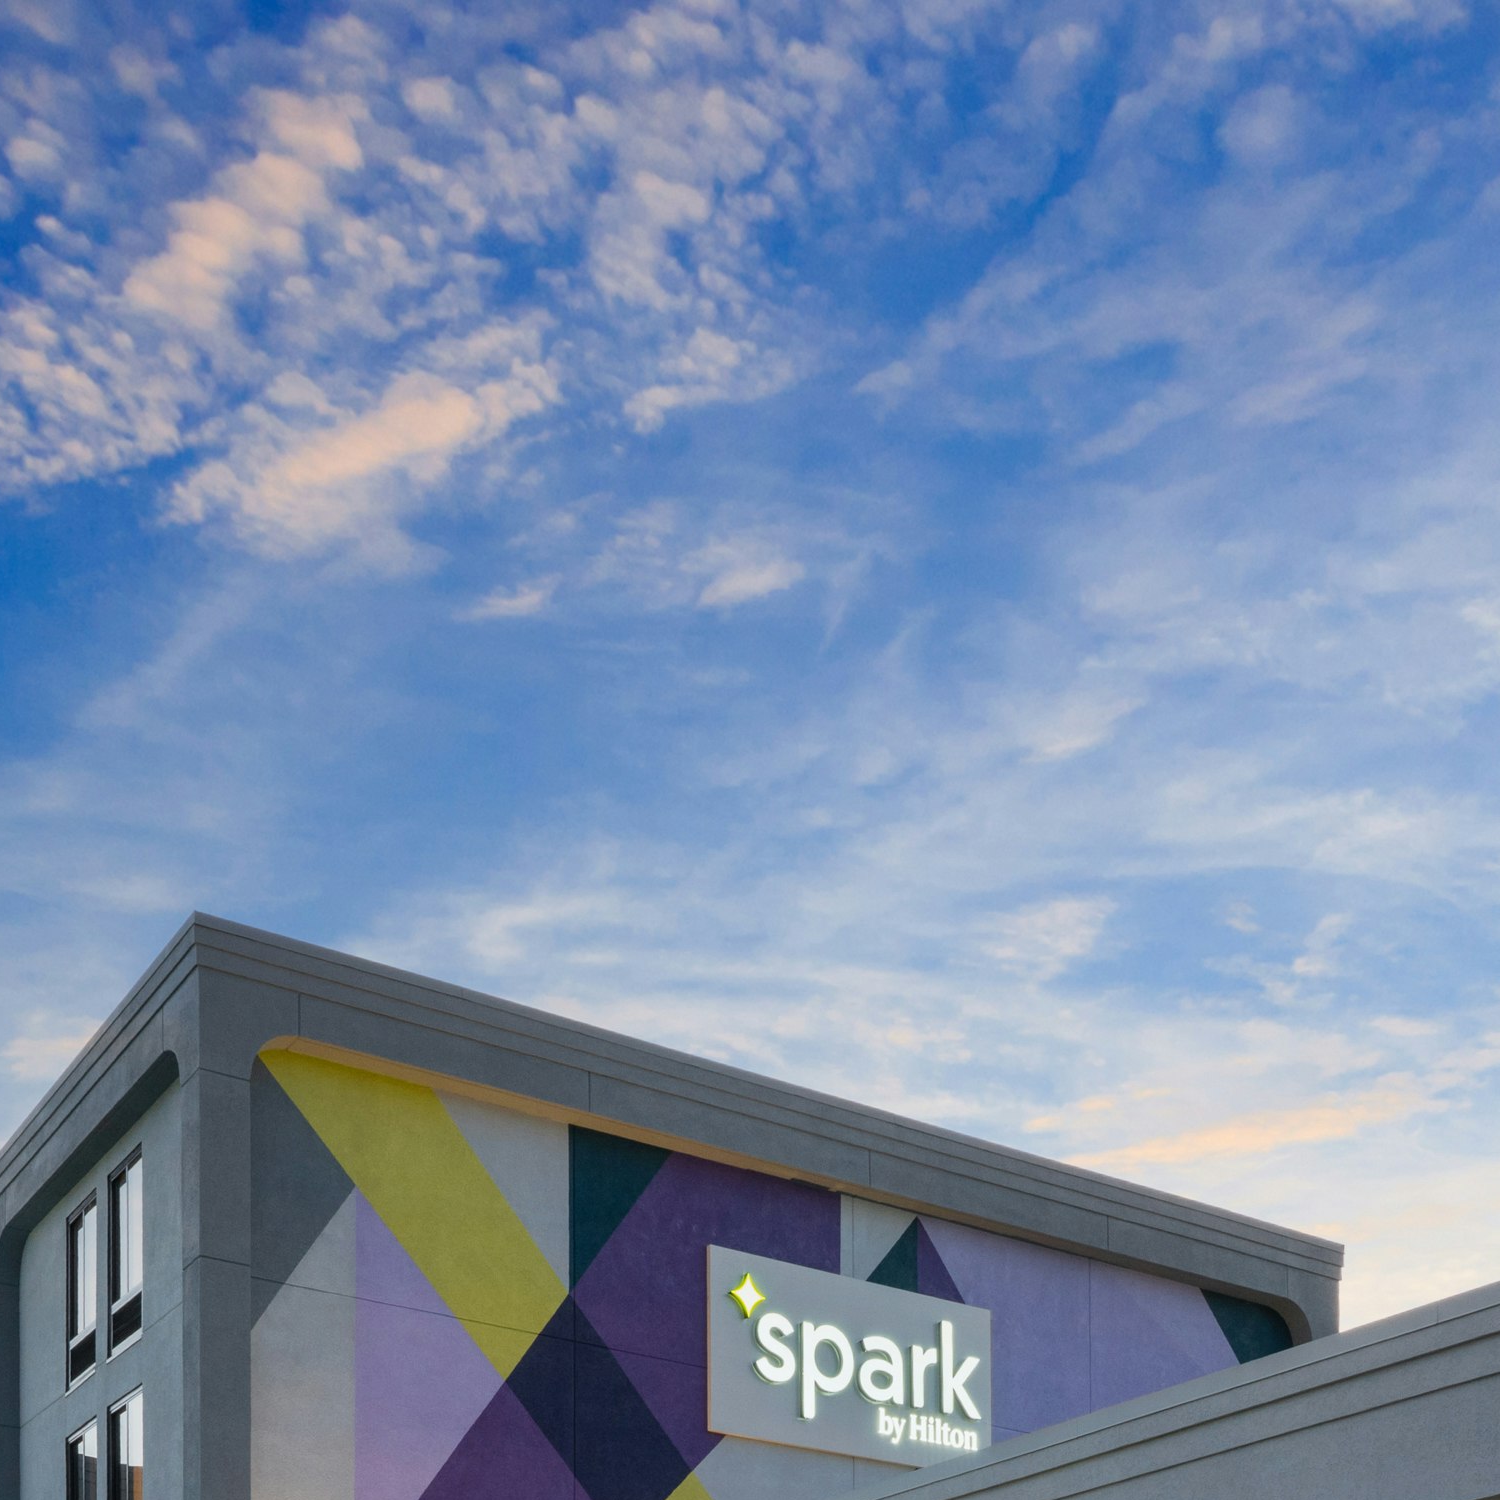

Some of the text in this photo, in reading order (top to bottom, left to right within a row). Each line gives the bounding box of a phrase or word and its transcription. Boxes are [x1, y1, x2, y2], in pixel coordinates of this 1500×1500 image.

[753, 1312, 982, 1420] spark
[878, 1406, 978, 1451] by Hilton
